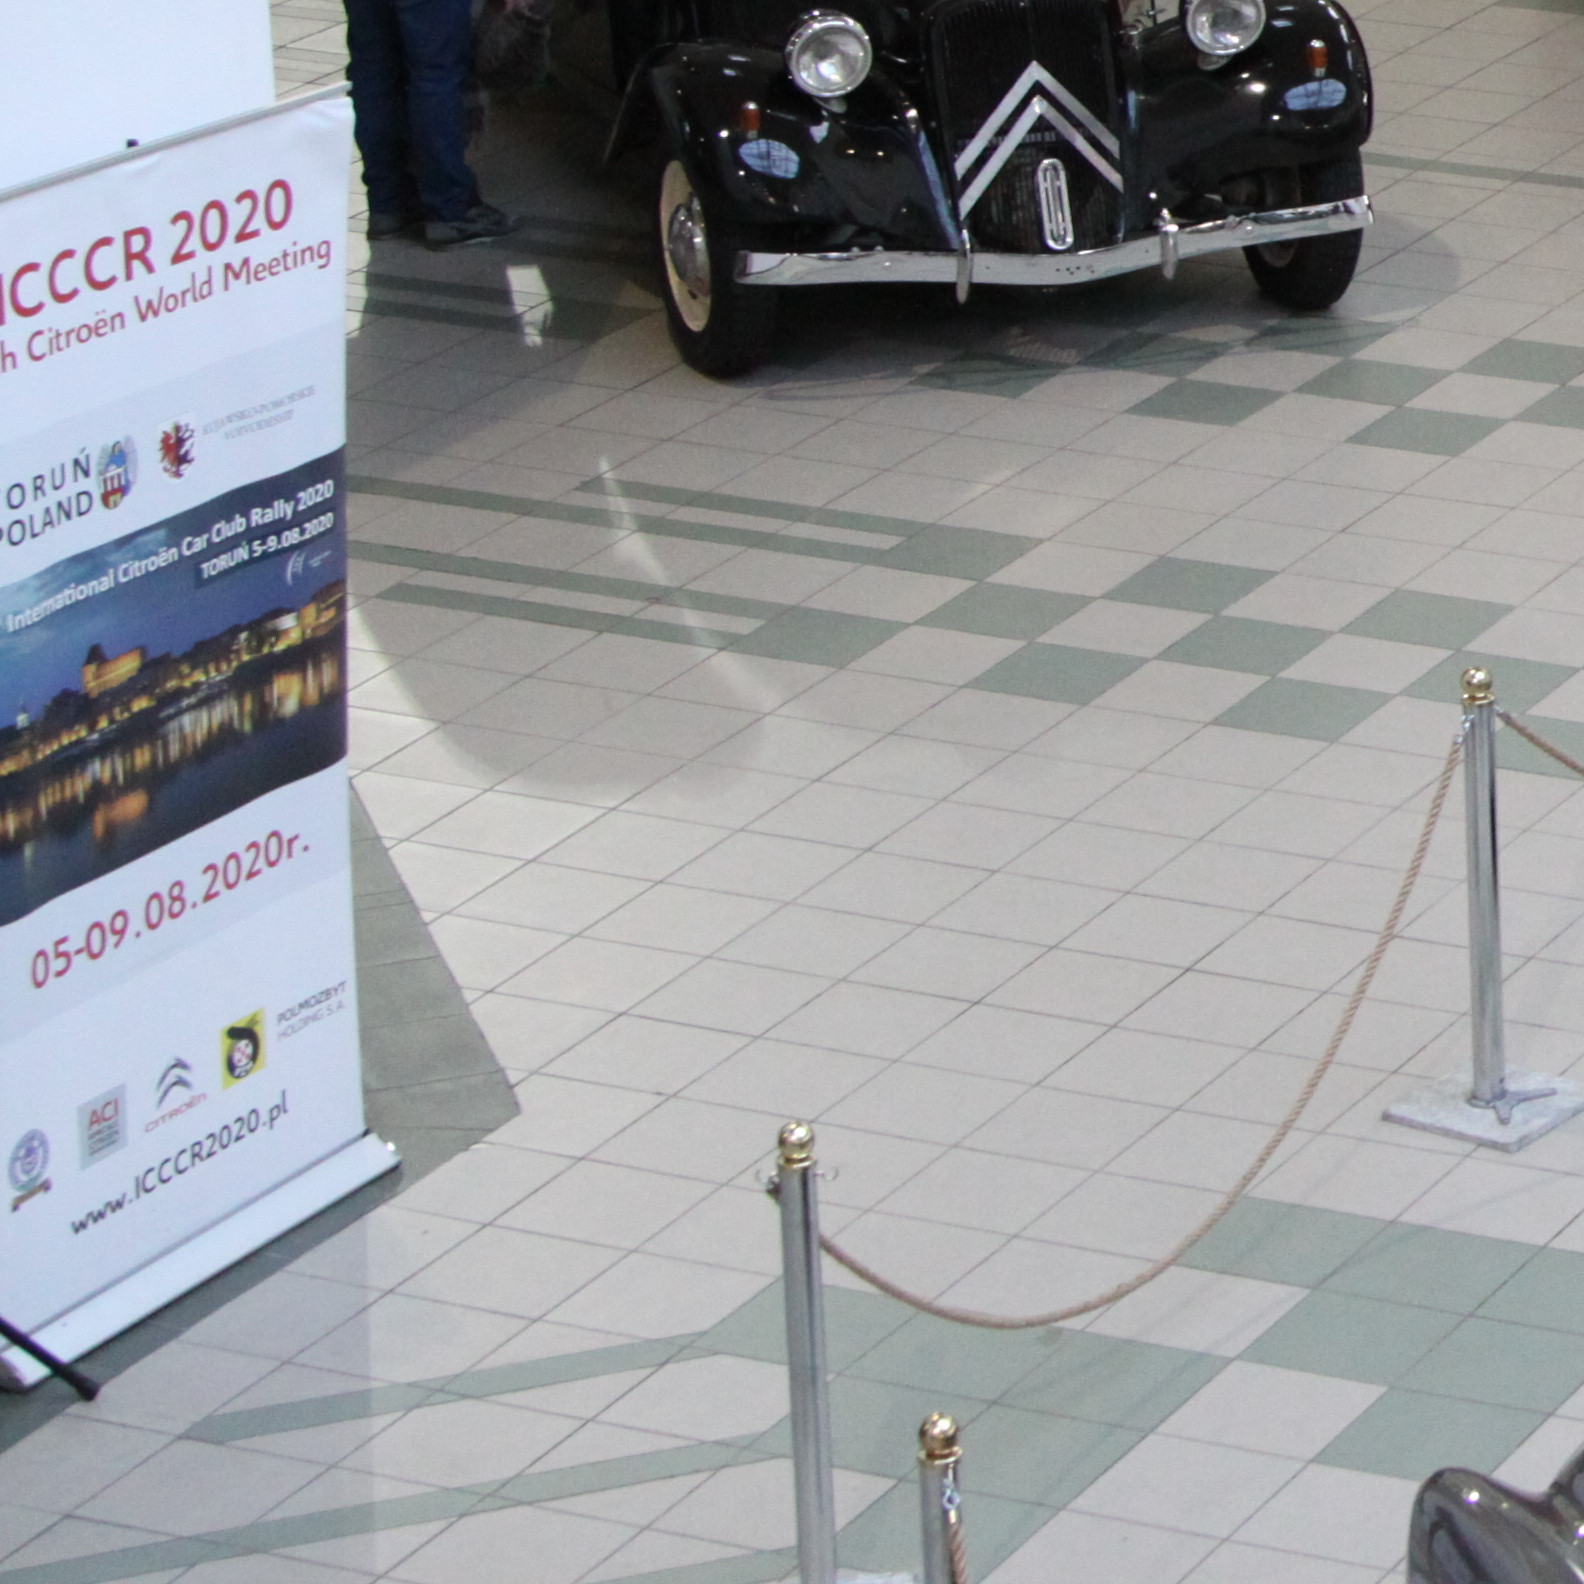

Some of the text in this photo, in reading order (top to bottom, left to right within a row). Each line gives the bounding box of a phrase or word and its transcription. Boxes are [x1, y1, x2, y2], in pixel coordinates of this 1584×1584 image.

[169, 178, 293, 266] 2020
[27, 309, 126, 362] Citroën
[133, 266, 214, 323] World
[222, 239, 332, 292] Meeting
[3, 446, 92, 510] ORUŃ
[5, 479, 334, 633] International Citroën Car Club Rally 2020
[200, 512, 335, 580] TORUŃ 5-9.08.2020
[31, 829, 310, 989] 05-09.08.2020r.
[70, 1089, 290, 1235] www.ICCCR2020.pl
